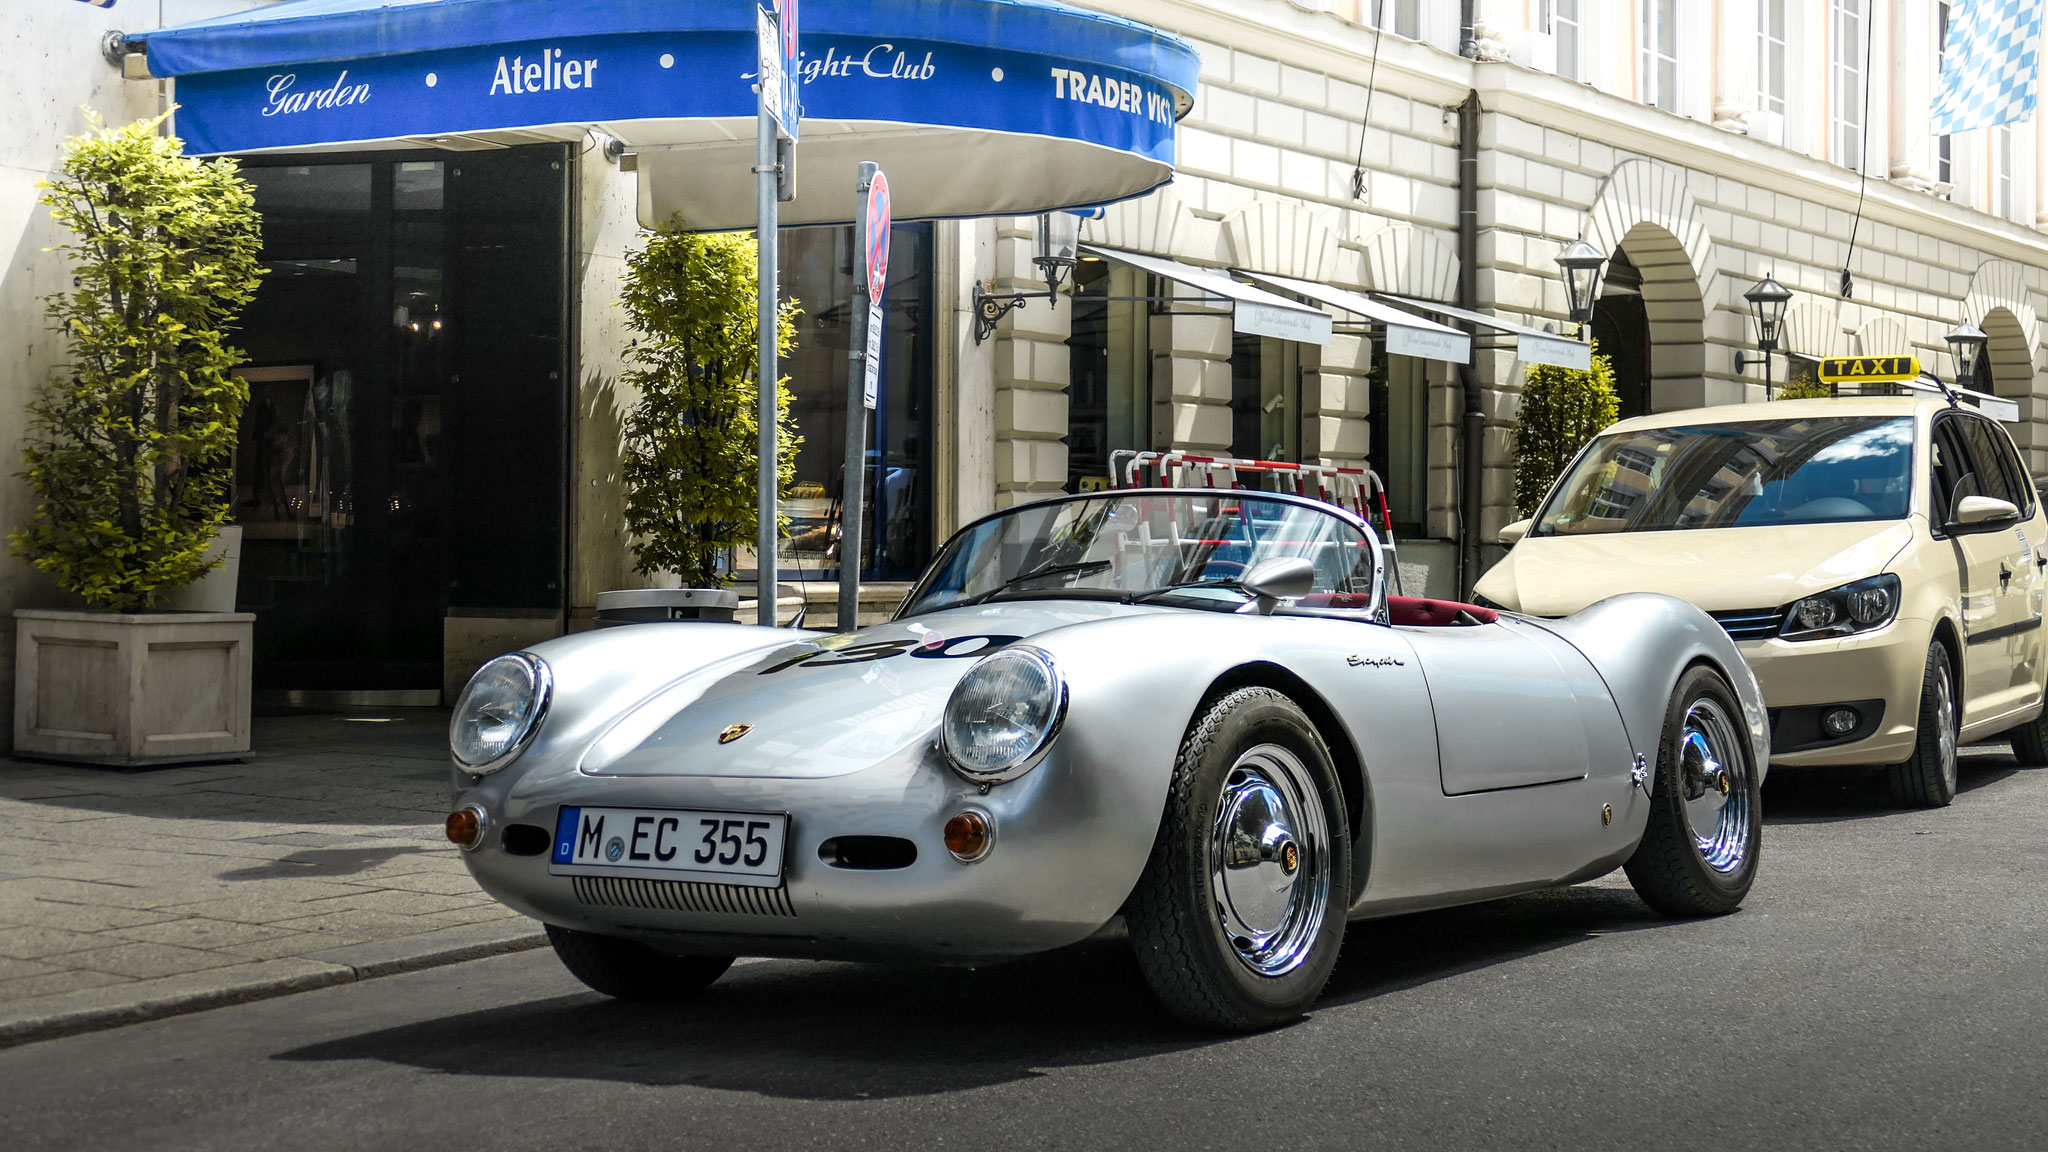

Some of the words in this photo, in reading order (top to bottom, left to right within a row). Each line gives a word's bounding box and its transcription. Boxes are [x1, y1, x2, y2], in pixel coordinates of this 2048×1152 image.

[262, 70, 371, 117] Garden
[489, 48, 598, 96] Atelier
[1051, 67, 1142, 115] TRADER
[1834, 358, 1899, 376] TAXI
[560, 842, 569, 855] D
[578, 814, 605, 858] M
[628, 816, 679, 862] EC
[694, 819, 771, 867] 355
